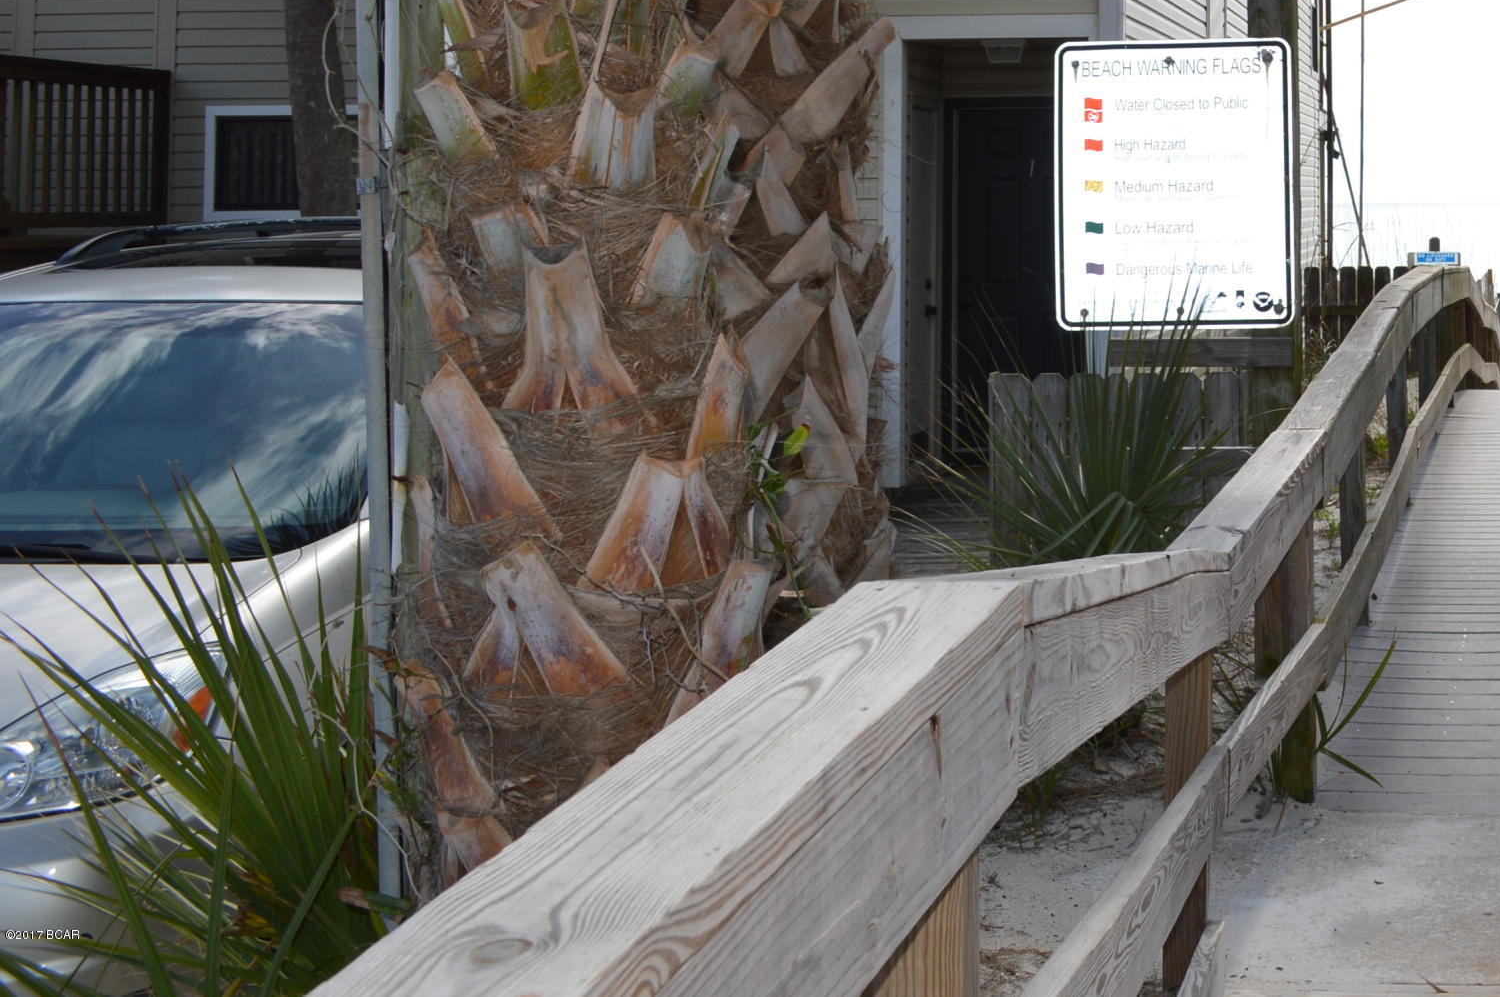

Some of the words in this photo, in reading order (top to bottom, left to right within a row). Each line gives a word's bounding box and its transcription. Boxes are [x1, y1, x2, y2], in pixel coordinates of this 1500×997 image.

[1081, 59, 1132, 78] BEACH
[1138, 57, 1208, 77] WARNING
[1212, 57, 1263, 75] FLAGS
[1114, 98, 1149, 112] Water
[1153, 98, 1195, 111] Closed
[1198, 98, 1209, 110] to
[1214, 96, 1249, 110] Public
[1114, 138, 1140, 155] High
[1144, 138, 1186, 151] Hazard
[1114, 180, 1164, 193] Medium
[1168, 179, 1214, 193] Hazard
[1114, 221, 1142, 235] Low
[1146, 221, 1194, 234] Hazard
[1115, 262, 1183, 279] Dangerous
[1231, 261, 1253, 275] Life
